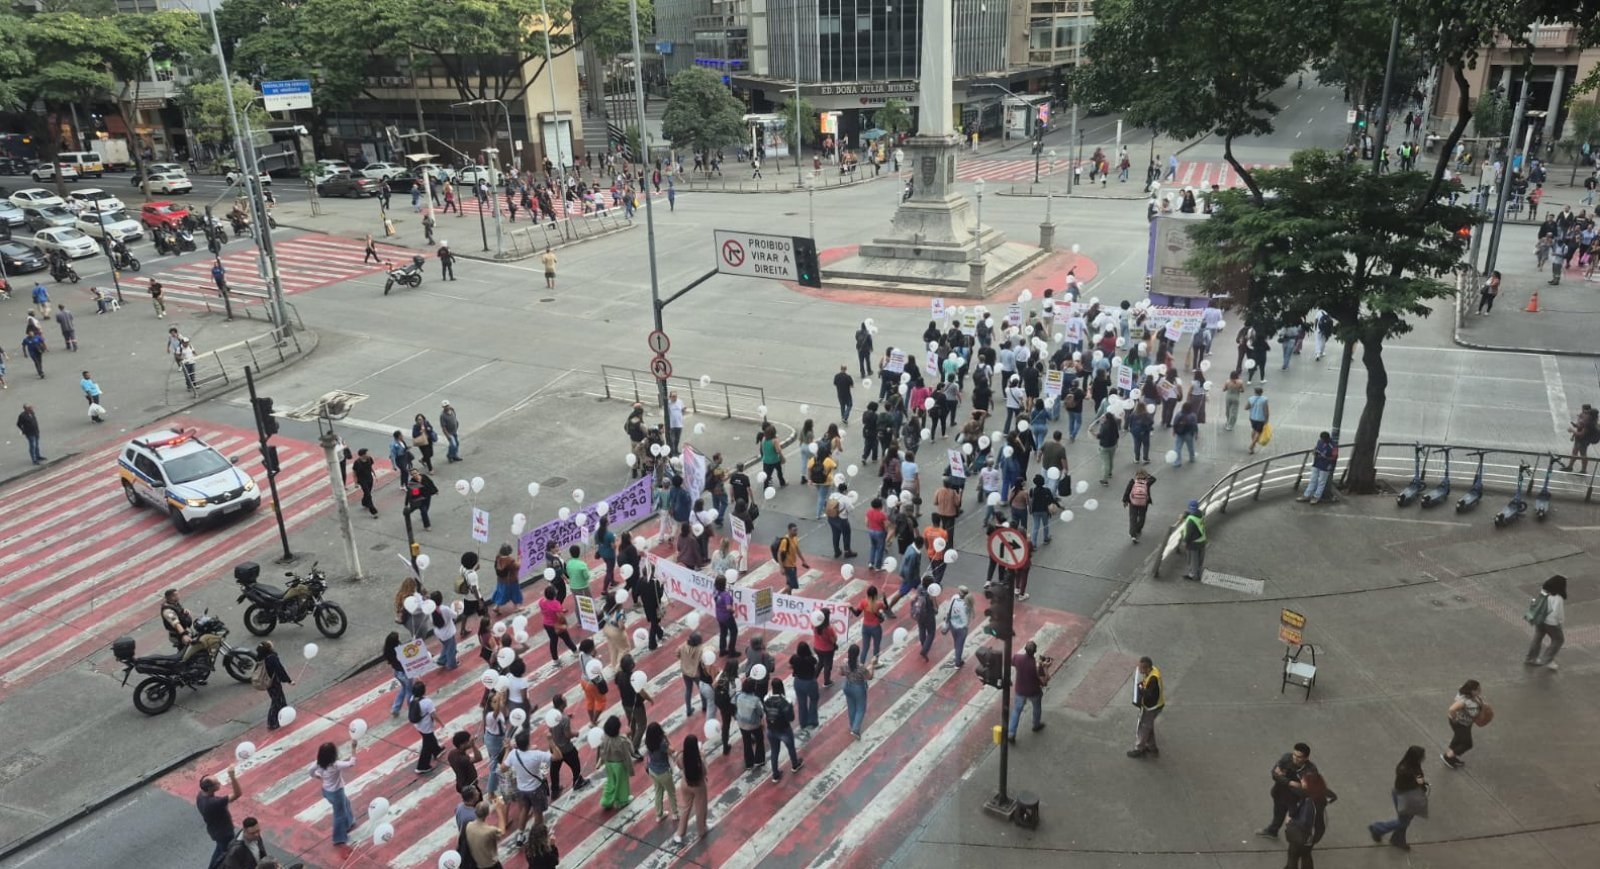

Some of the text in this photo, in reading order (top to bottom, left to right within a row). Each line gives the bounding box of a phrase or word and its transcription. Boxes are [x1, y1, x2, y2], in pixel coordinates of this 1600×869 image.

[822, 86, 834, 95] ED.
[836, 85, 857, 94] DONA
[887, 84, 915, 92] NUNES
[749, 238, 790, 251] PROIBIDO
[752, 251, 779, 262] VIRAR
[755, 263, 788, 275] DIREITA
